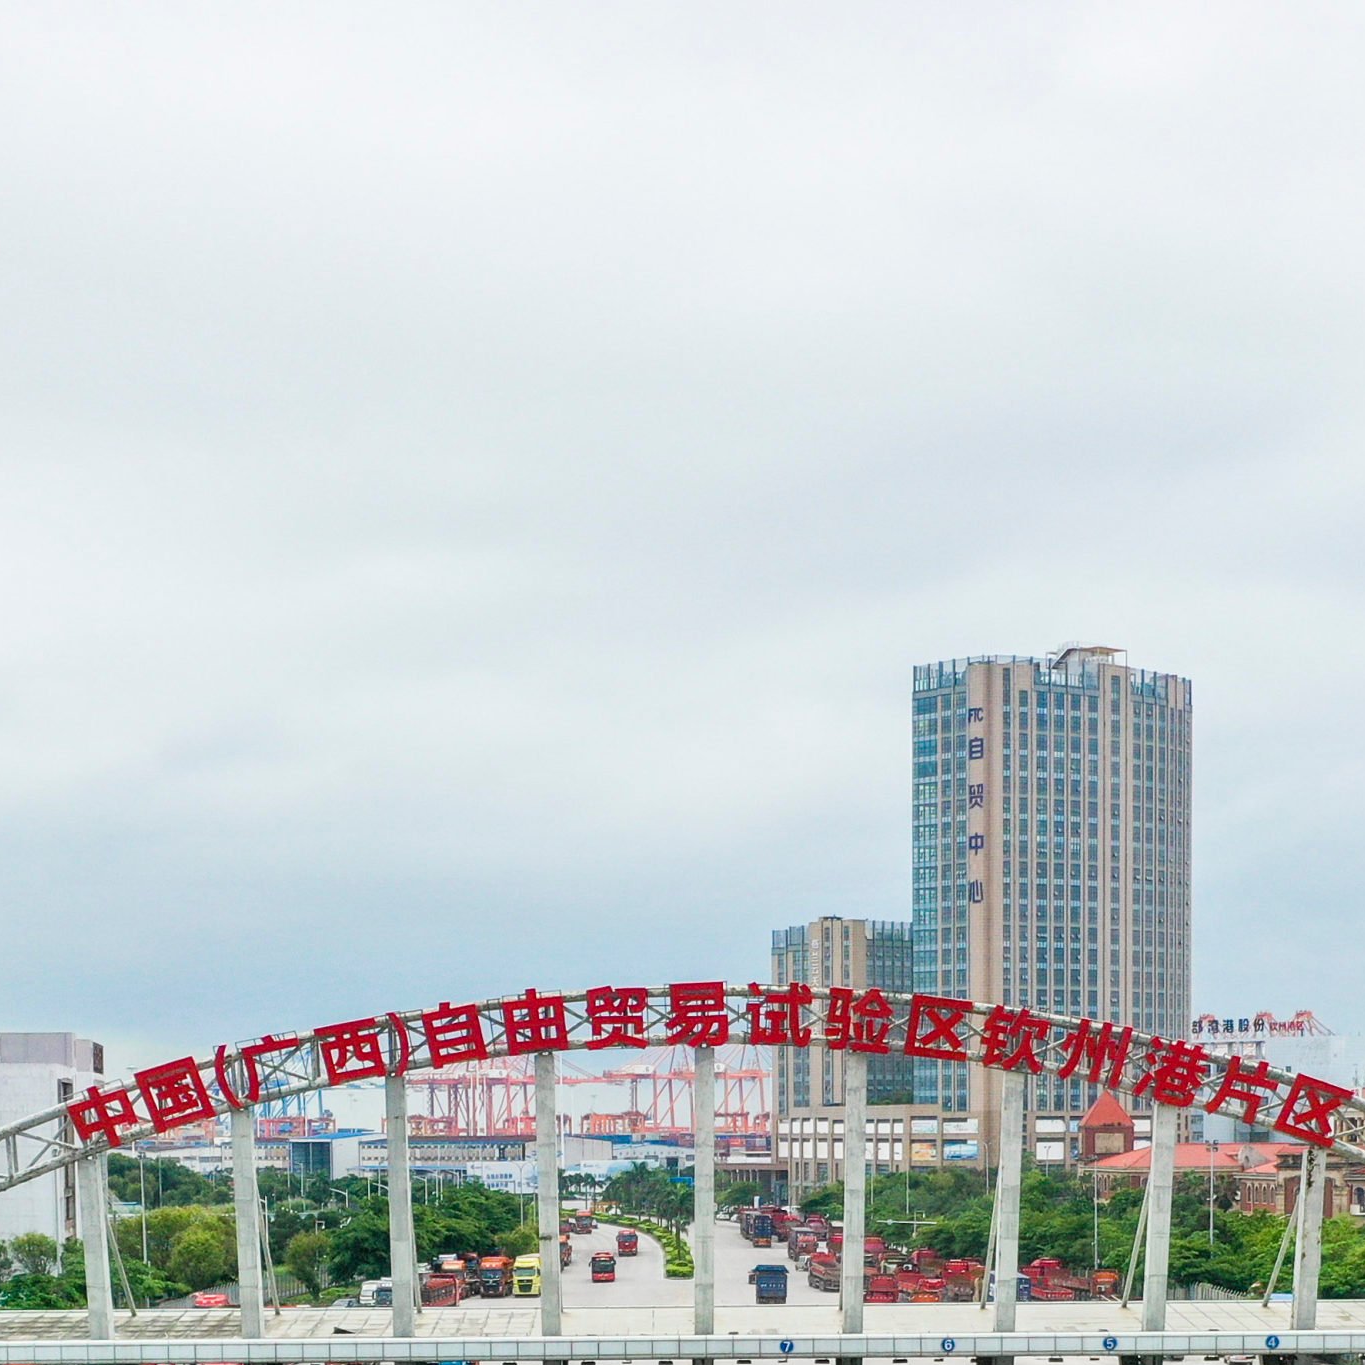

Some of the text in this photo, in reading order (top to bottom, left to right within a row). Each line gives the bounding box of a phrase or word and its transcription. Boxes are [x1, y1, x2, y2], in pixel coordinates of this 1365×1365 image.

[968, 707, 983, 722] FTC
[968, 737, 984, 903] 自贸中心
